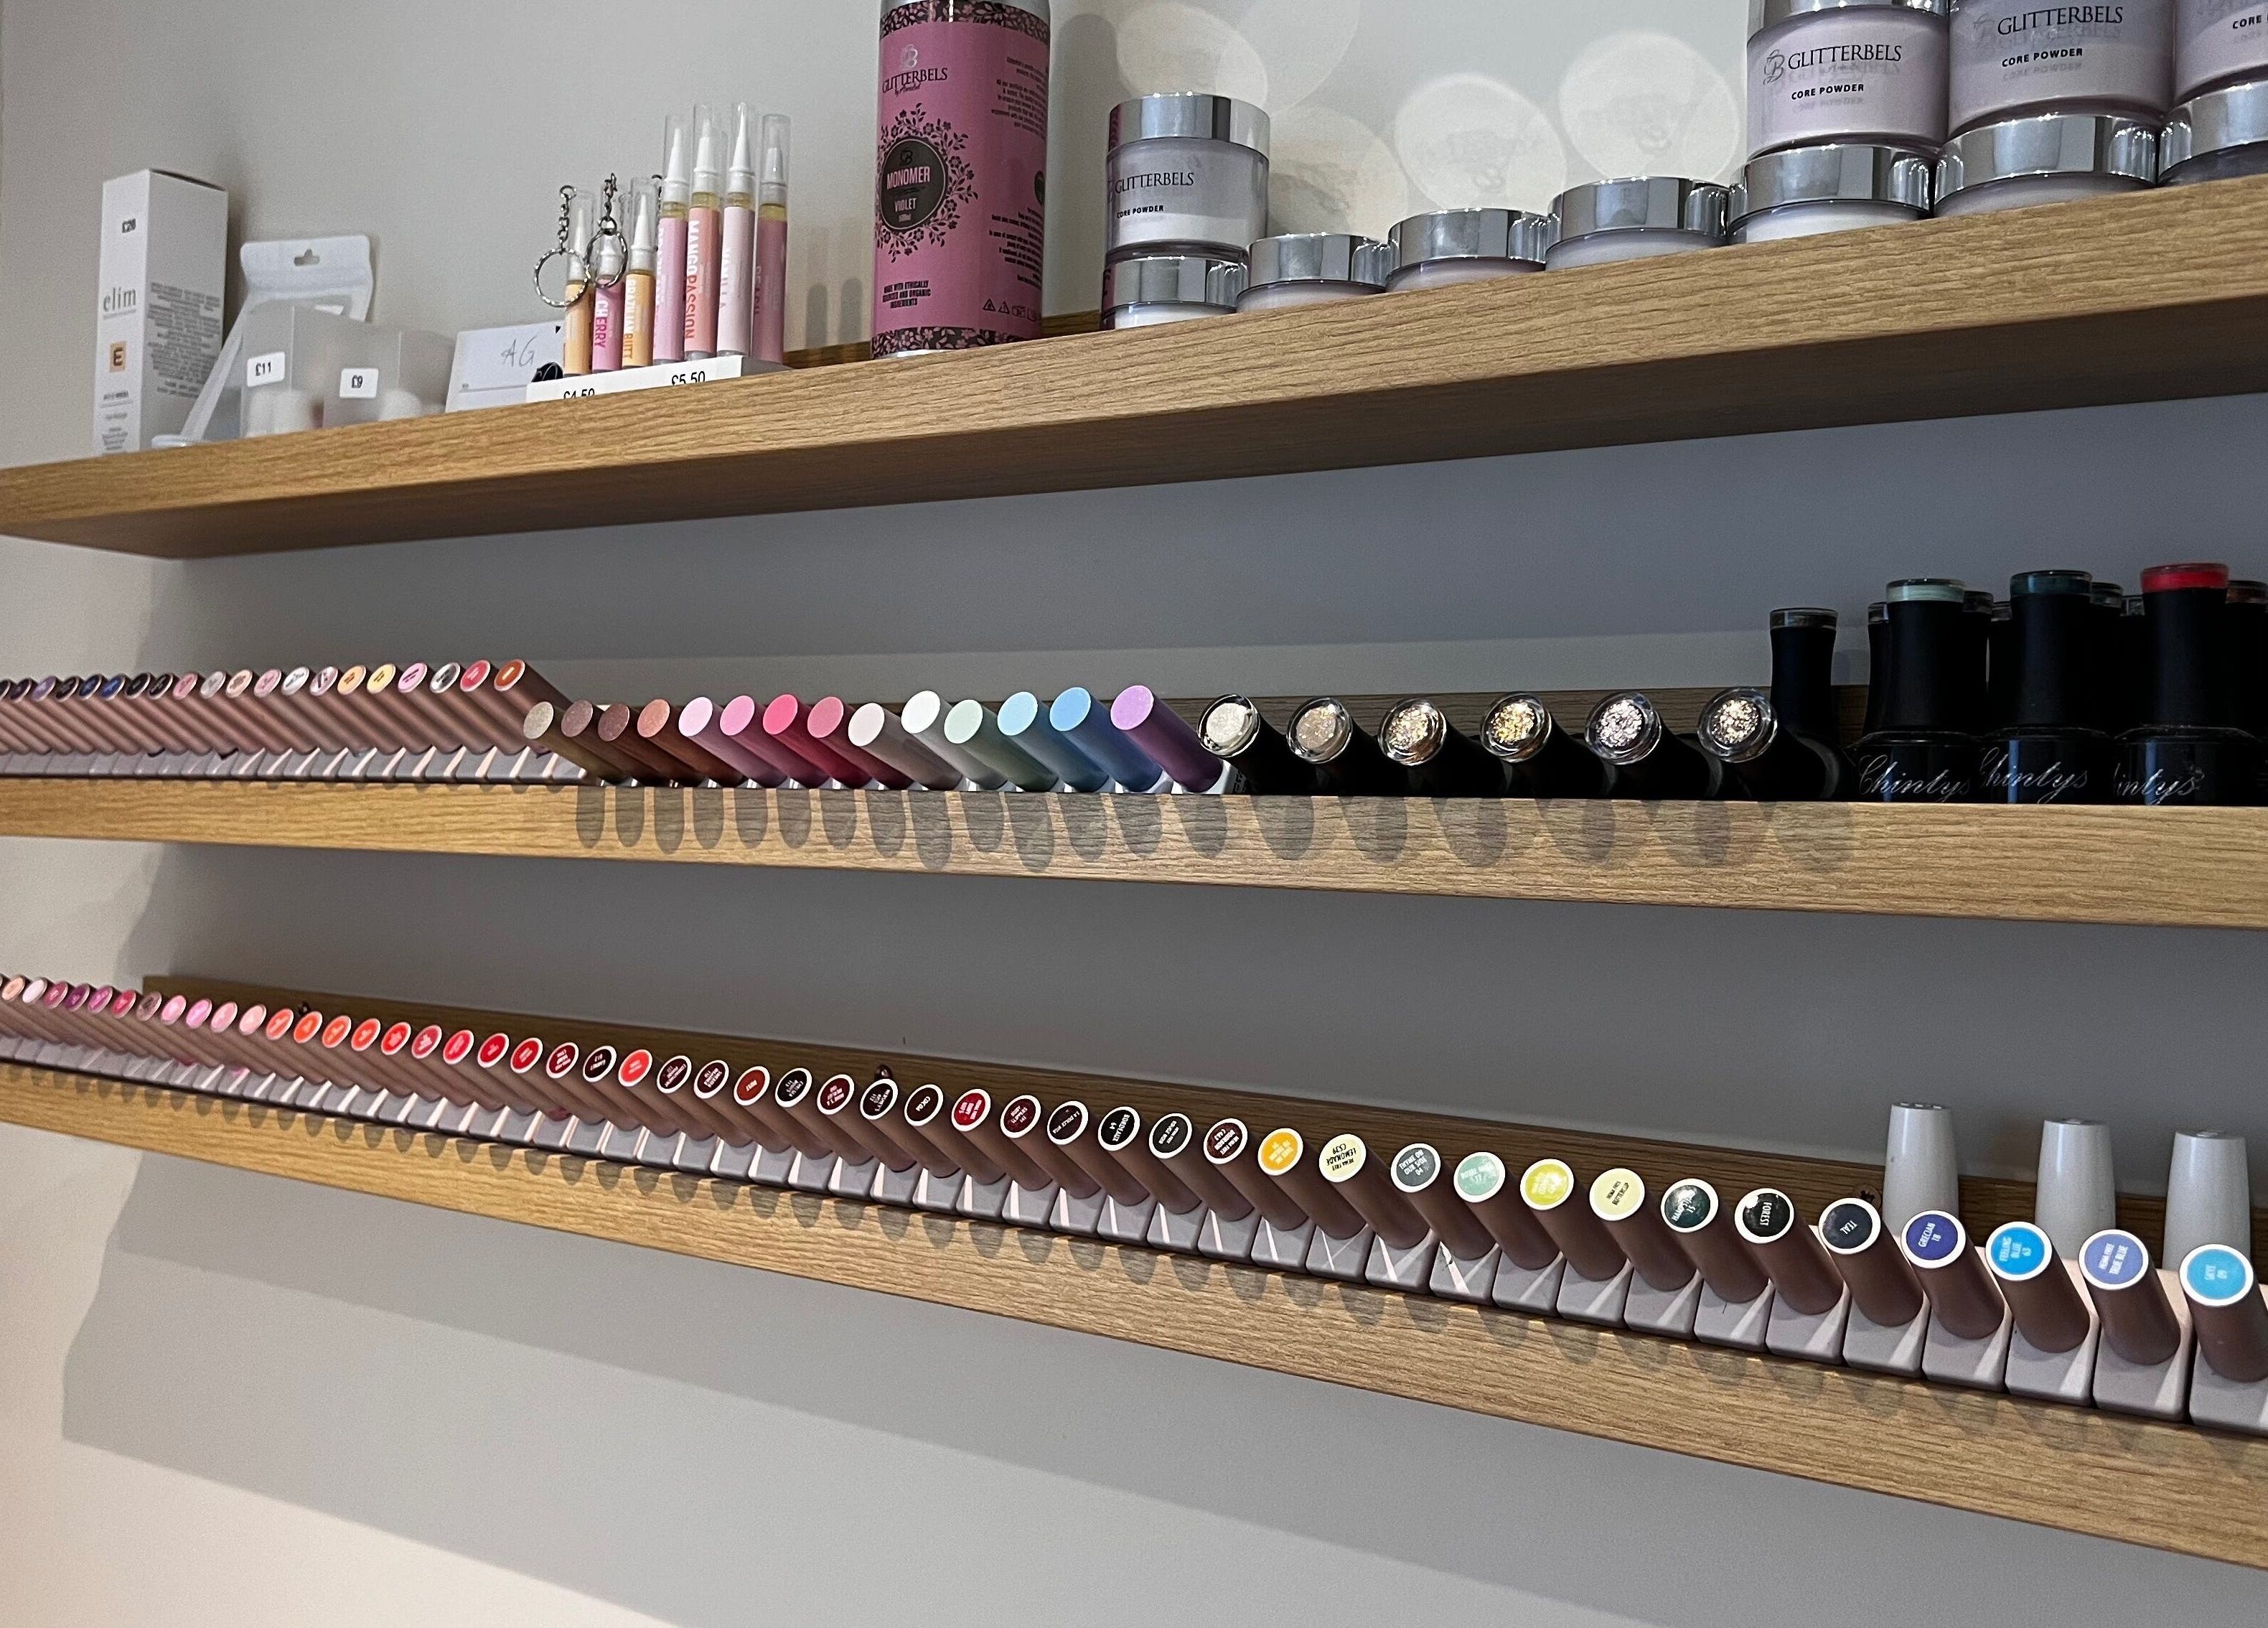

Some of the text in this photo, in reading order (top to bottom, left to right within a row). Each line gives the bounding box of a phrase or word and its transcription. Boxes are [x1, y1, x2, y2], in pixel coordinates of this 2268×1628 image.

[1997, 6, 2123, 35] GLITTERBELS
[2232, 15, 2262, 29] CORE
[1788, 44, 1902, 70] GLITTERBELS
[2002, 47, 2083, 67] CORE POWDER
[882, 67, 948, 93] GLITTERBELS
[1791, 83, 1864, 100] CORE POWDER
[886, 166, 930, 190] MONOMER
[1115, 172, 1194, 194] GLITTERBELS
[894, 197, 917, 212] VIOLET
[1117, 205, 1164, 218] CORE POWDER
[103, 286, 136, 312] elim
[684, 275, 697, 340] PASSION
[594, 299, 609, 348] CHERRY
[113, 347, 123, 367] E
[255, 361, 271, 377] £11
[671, 370, 706, 386] £550
[351, 375, 363, 389] £9
[563, 388, 596, 400] £450
[915, 1096, 931, 1112] COCOA
[1061, 1115, 1074, 1128] DOLCE
[1112, 1113, 1130, 1142] BORDEAUX
[1326, 1148, 1356, 1166] LEMONADE
[1341, 1157, 1354, 1166] HEMA
[1398, 1149, 1425, 1170] THYME ON
[1403, 1156, 1428, 1175] OUR SIDE
[1612, 1182, 1629, 1206] BUTTERCUP
[1759, 1202, 1773, 1226] FOREST
[1840, 1220, 1858, 1235] TEAL
[1918, 1222, 1936, 1248] GRECIAN
[2010, 1243, 2022, 1258] BLUE
[2108, 1245, 2129, 1275] TRUE BLUE
